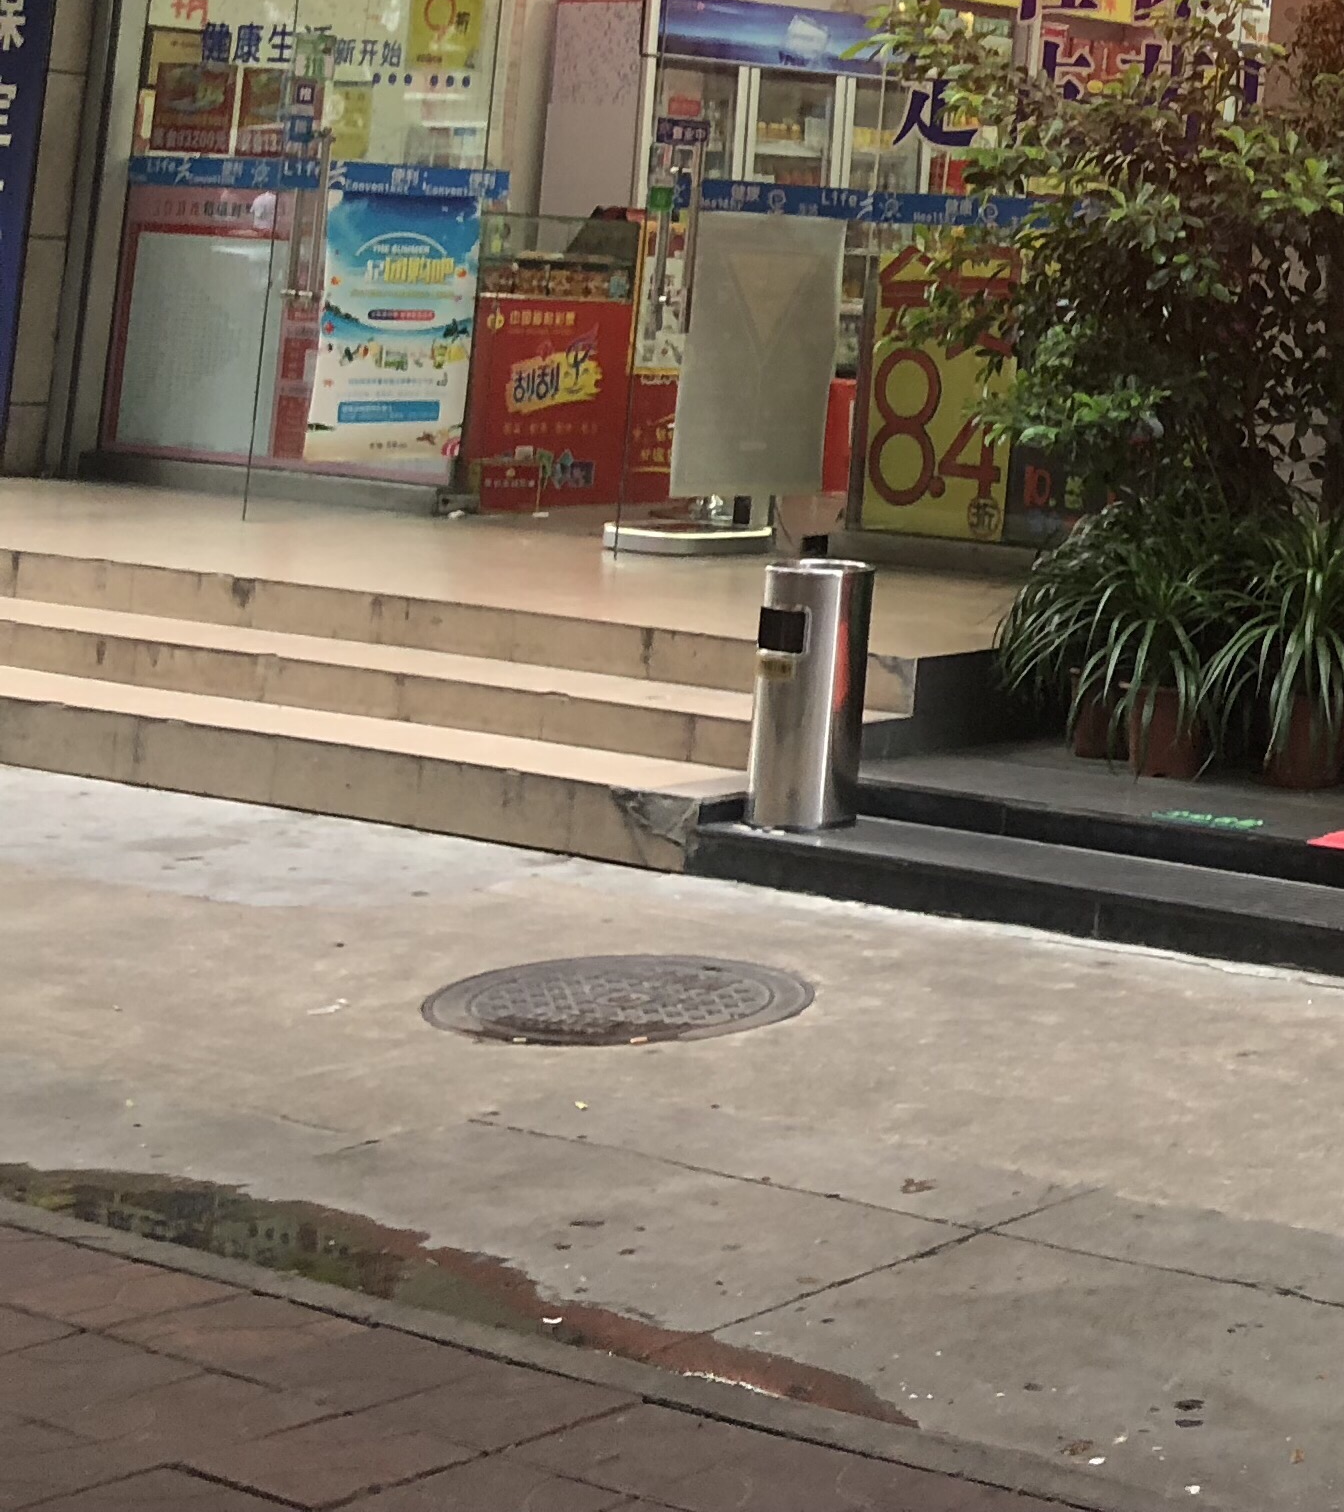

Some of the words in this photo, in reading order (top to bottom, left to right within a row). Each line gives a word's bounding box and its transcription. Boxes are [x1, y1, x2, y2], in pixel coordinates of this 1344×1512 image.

[202, 22, 402, 68] 健康生新开始
